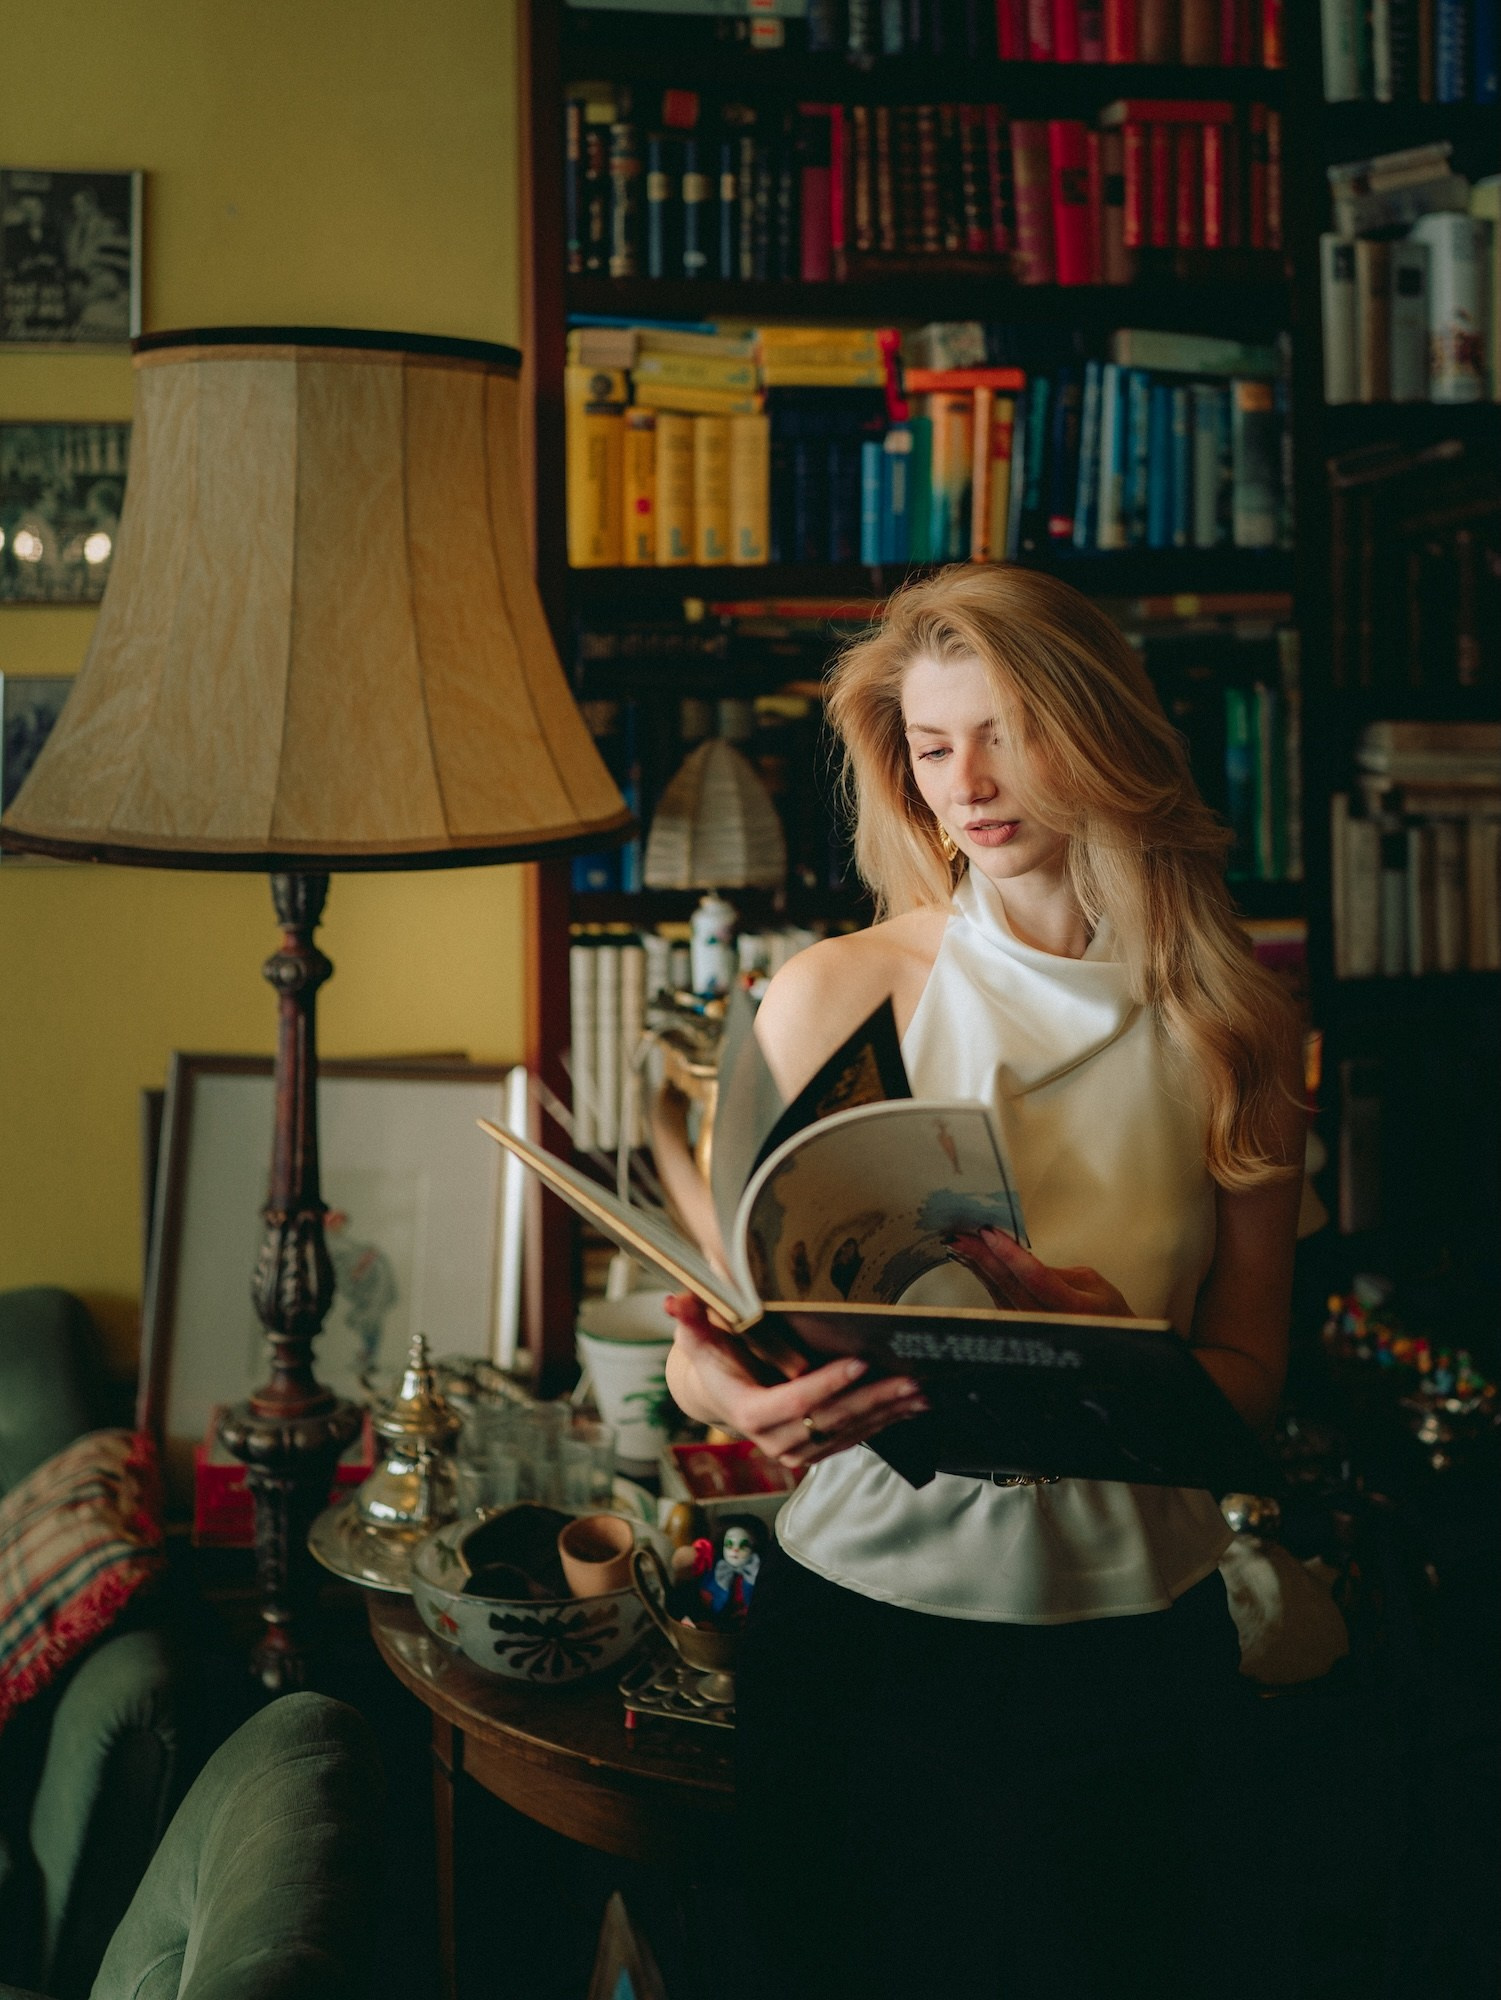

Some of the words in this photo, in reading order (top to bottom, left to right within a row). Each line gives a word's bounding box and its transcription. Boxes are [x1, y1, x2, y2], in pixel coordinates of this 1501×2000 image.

[671, 527, 689, 558] L
[706, 528, 725, 558] L
[740, 527, 760, 558] L
